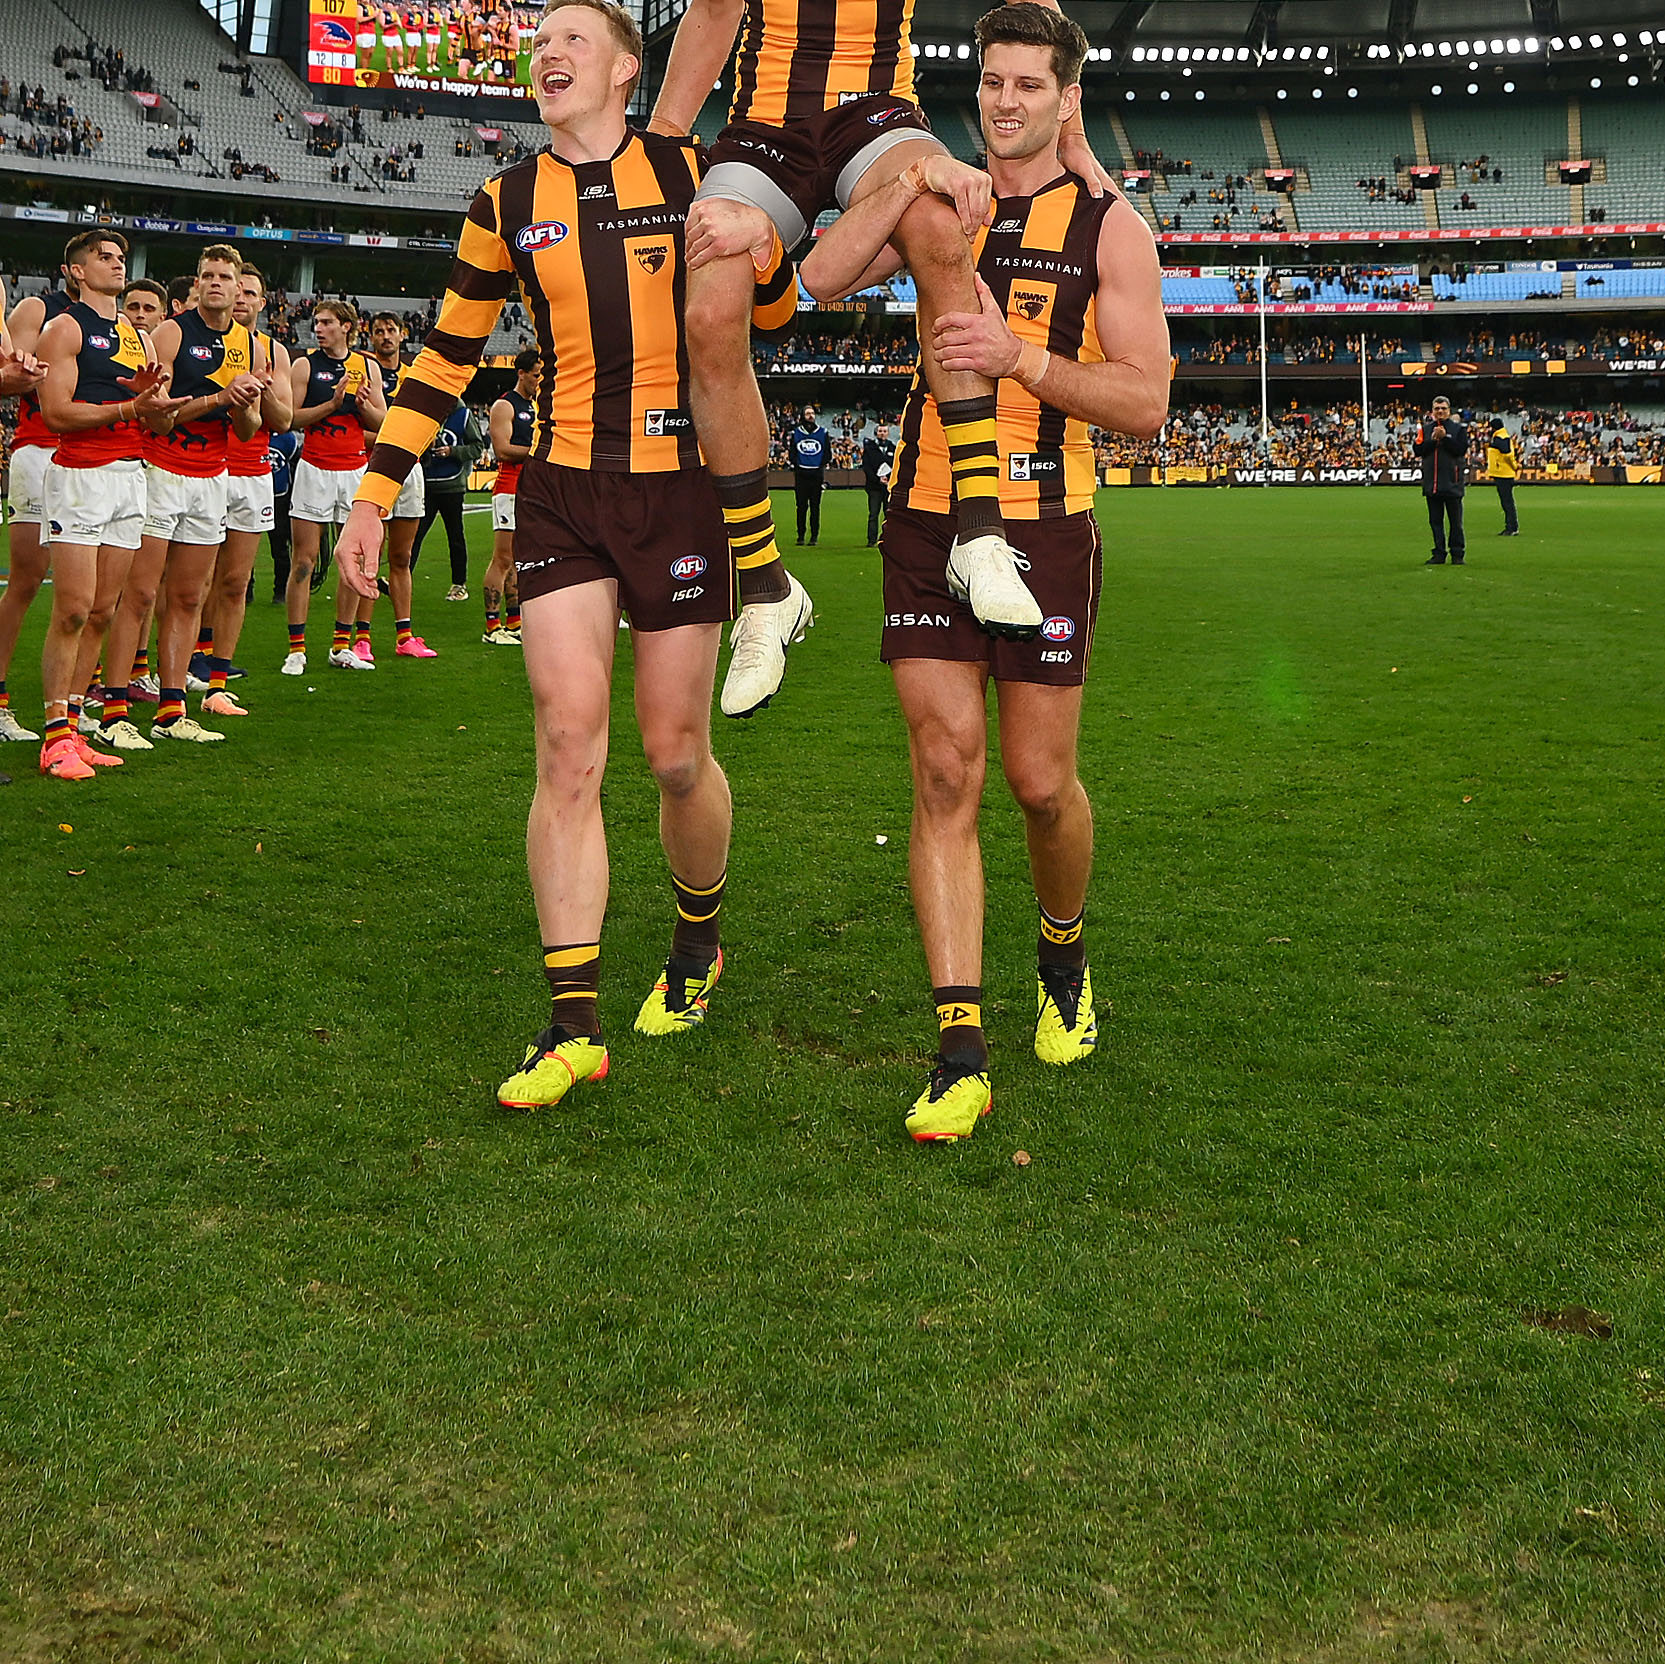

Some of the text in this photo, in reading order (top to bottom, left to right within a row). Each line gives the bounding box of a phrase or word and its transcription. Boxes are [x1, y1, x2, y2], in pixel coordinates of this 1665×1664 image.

[316, 53, 347, 66] 12 8
[323, 68, 341, 84] 80
[393, 74, 428, 90] We're
[431, 80, 440, 91] a
[442, 76, 479, 97] happy
[481, 83, 510, 97] team
[512, 85, 524, 98] at
[77, 212, 124, 226] IDIOM
[597, 213, 686, 231] TASMANIAN
[252, 228, 283, 239] OPTUS
[520, 225, 564, 248] AFL
[634, 246, 668, 256] HAWKS
[995, 257, 1083, 277] TASMANIAN
[1160, 267, 1193, 278] brokes
[1013, 291, 1049, 303] HAWKS
[783, 364, 827, 374] HAPPY
[830, 364, 866, 374] TEAM
[868, 364, 884, 374] AT
[1609, 360, 1656, 370] WE'RE
[1235, 469, 1423, 482] WE'RE A HAPPY TEA
[674, 558, 704, 576] AFL
[885, 613, 950, 627] ISSAN
[1043, 618, 1073, 634] AFL
